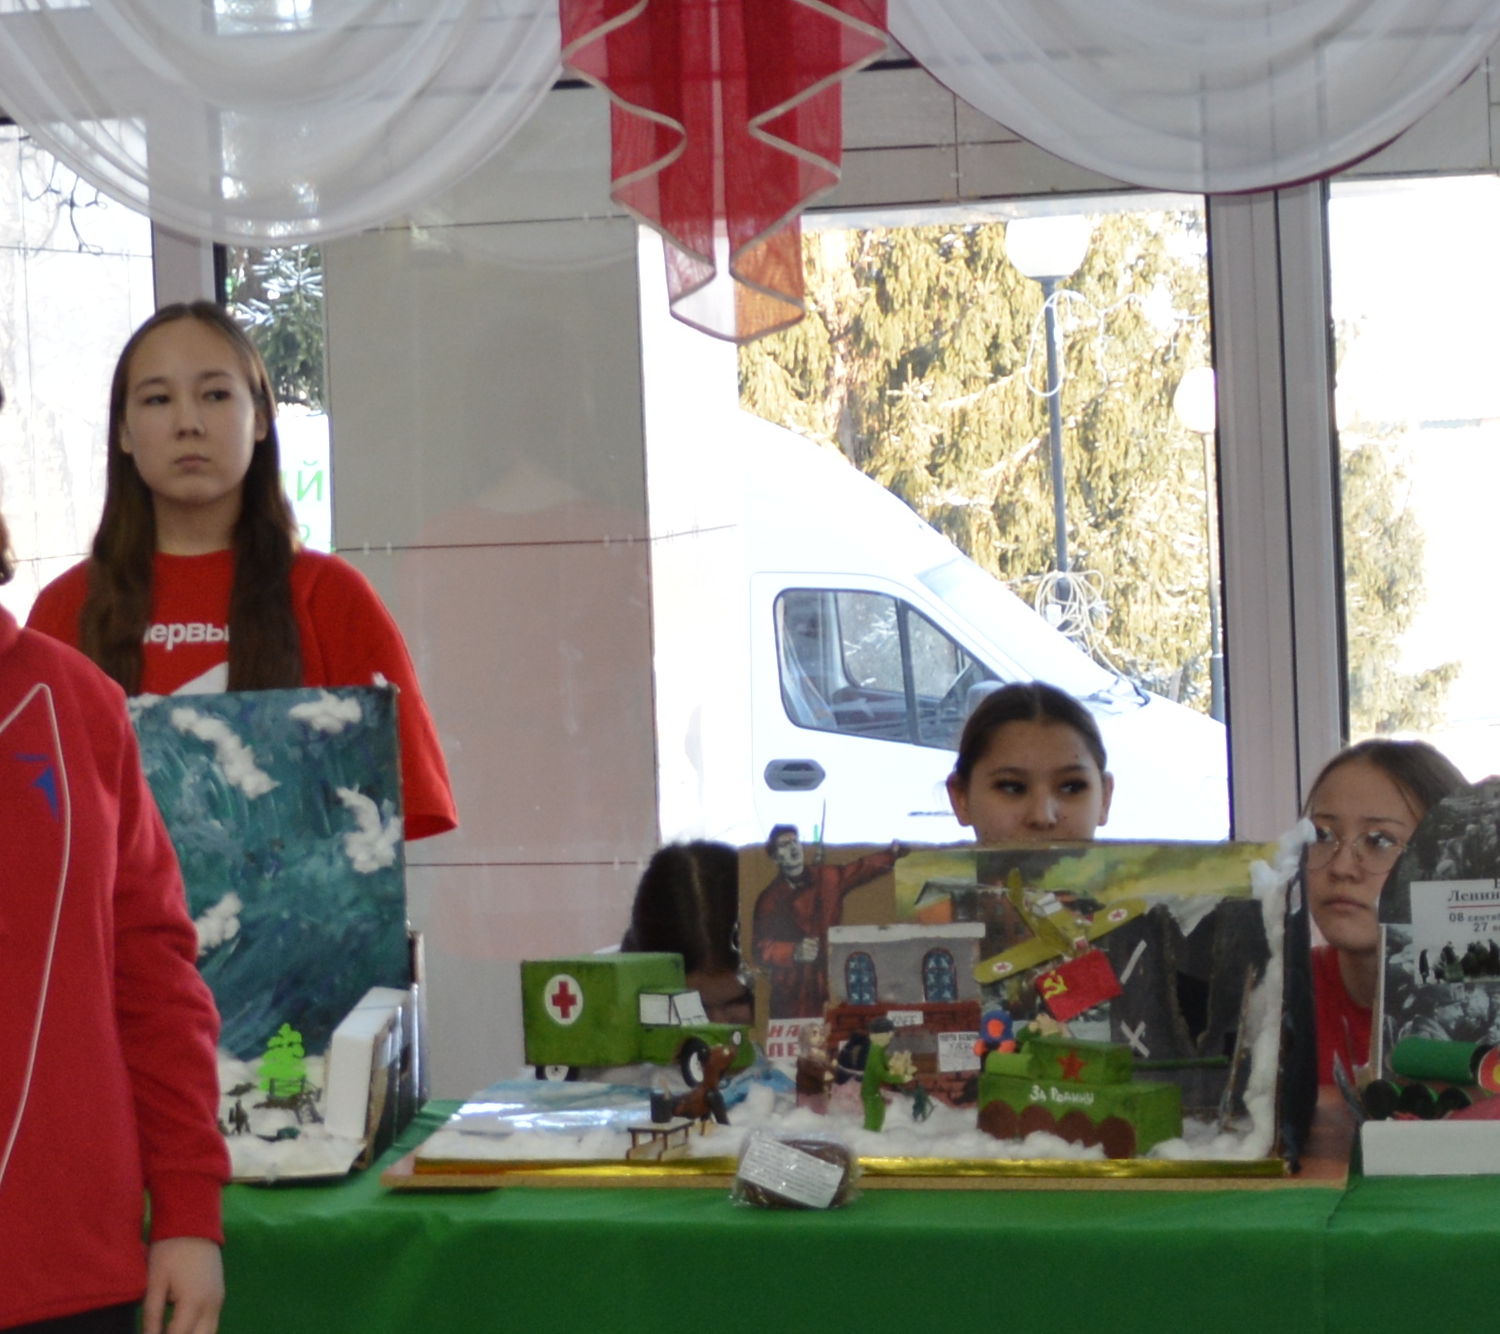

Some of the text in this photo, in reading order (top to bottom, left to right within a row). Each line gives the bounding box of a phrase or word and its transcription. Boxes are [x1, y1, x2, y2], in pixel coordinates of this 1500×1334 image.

[144, 623, 230, 651] ервы
[1448, 912, 1465, 923] 08
[1473, 922, 1488, 933] 27
